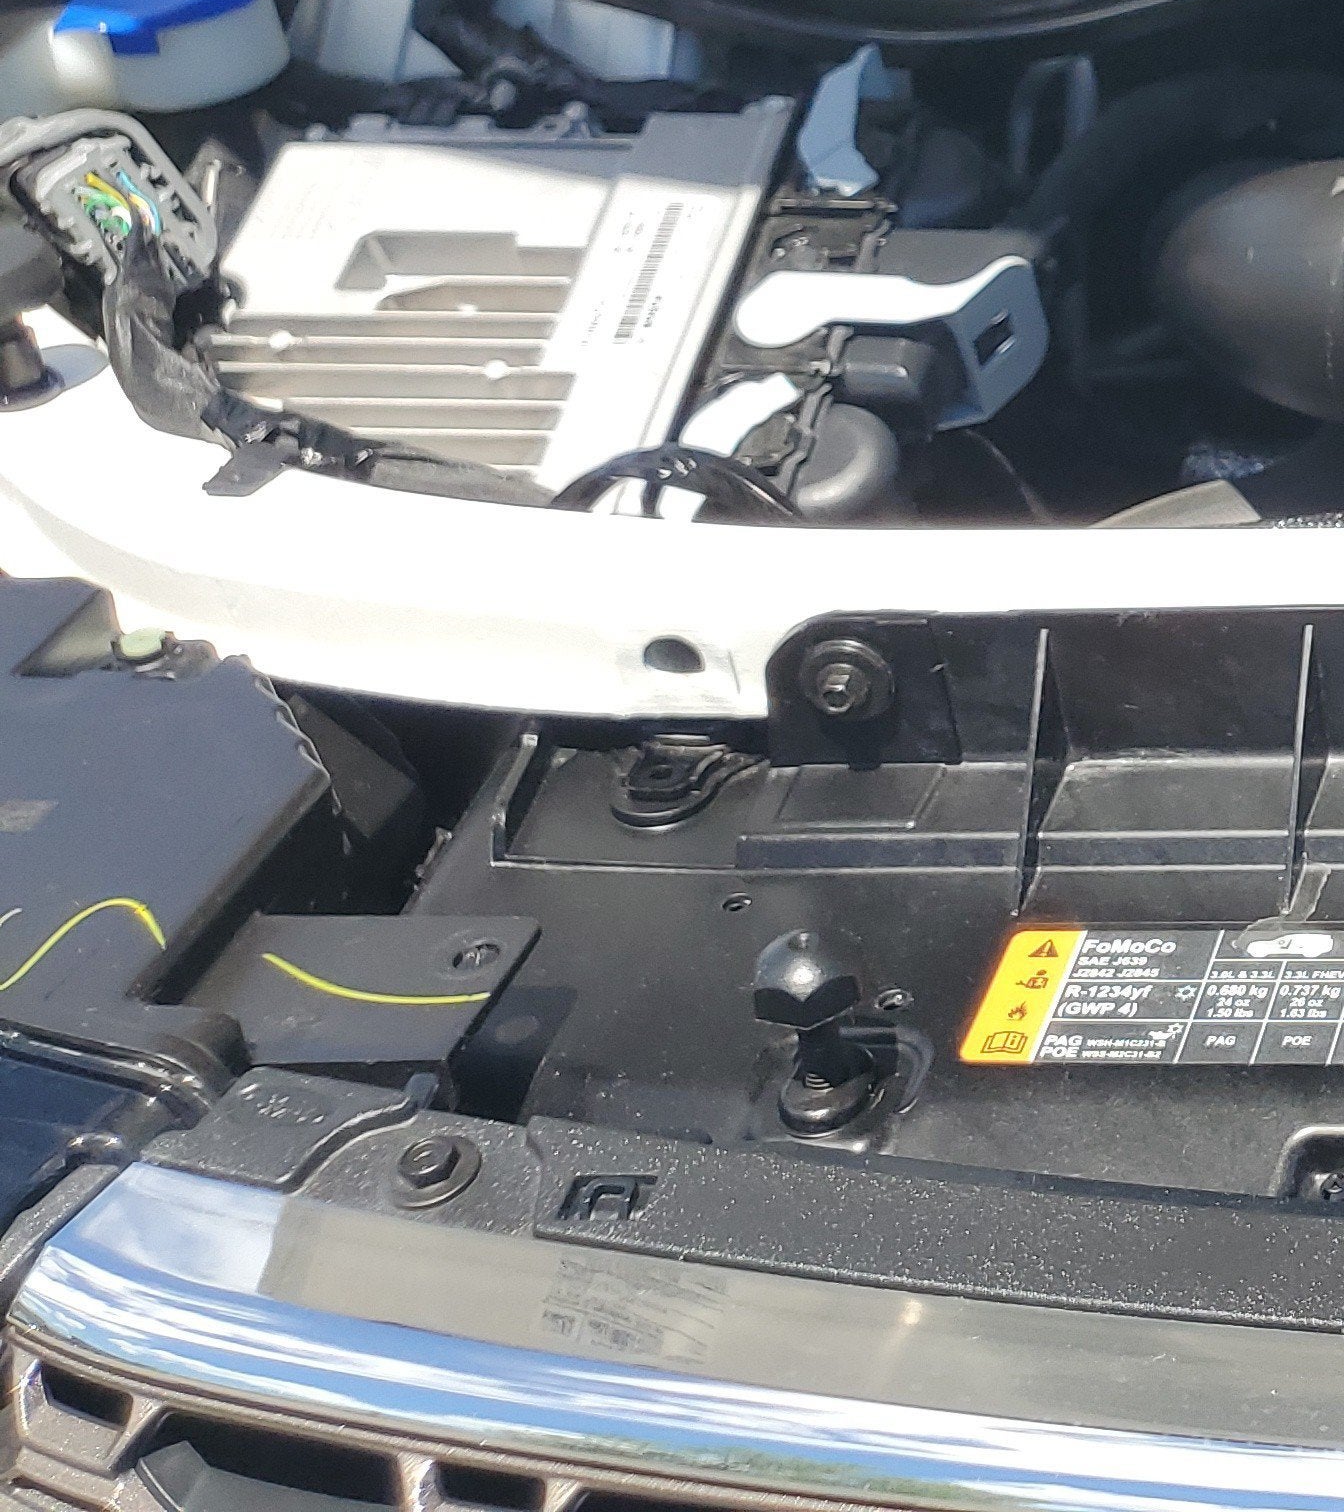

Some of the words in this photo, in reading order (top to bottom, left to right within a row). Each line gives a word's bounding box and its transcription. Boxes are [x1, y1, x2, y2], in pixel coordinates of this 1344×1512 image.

[1081, 938, 1177, 954] FoMoCo
[1077, 956, 1111, 965] SAE
[1064, 984, 1154, 1000] R-1234yf
[1206, 984, 1247, 996] 0.680
[1249, 984, 1269, 998] kg
[1279, 984, 1319, 996] 0.737
[1321, 984, 1342, 998] kg
[1234, 998, 1251, 1007] oz
[1307, 998, 1324, 1007] oz
[1057, 1002, 1116, 1017] (GWP
[1117, 1002, 1138, 1017] 4)
[1233, 1007, 1254, 1018] lbs
[1307, 1007, 1327, 1018] lbs
[1043, 1034, 1083, 1046] PAG
[1206, 1035, 1237, 1046] PAG
[1282, 1035, 1312, 1046] POE
[1039, 1046, 1080, 1058] POE
